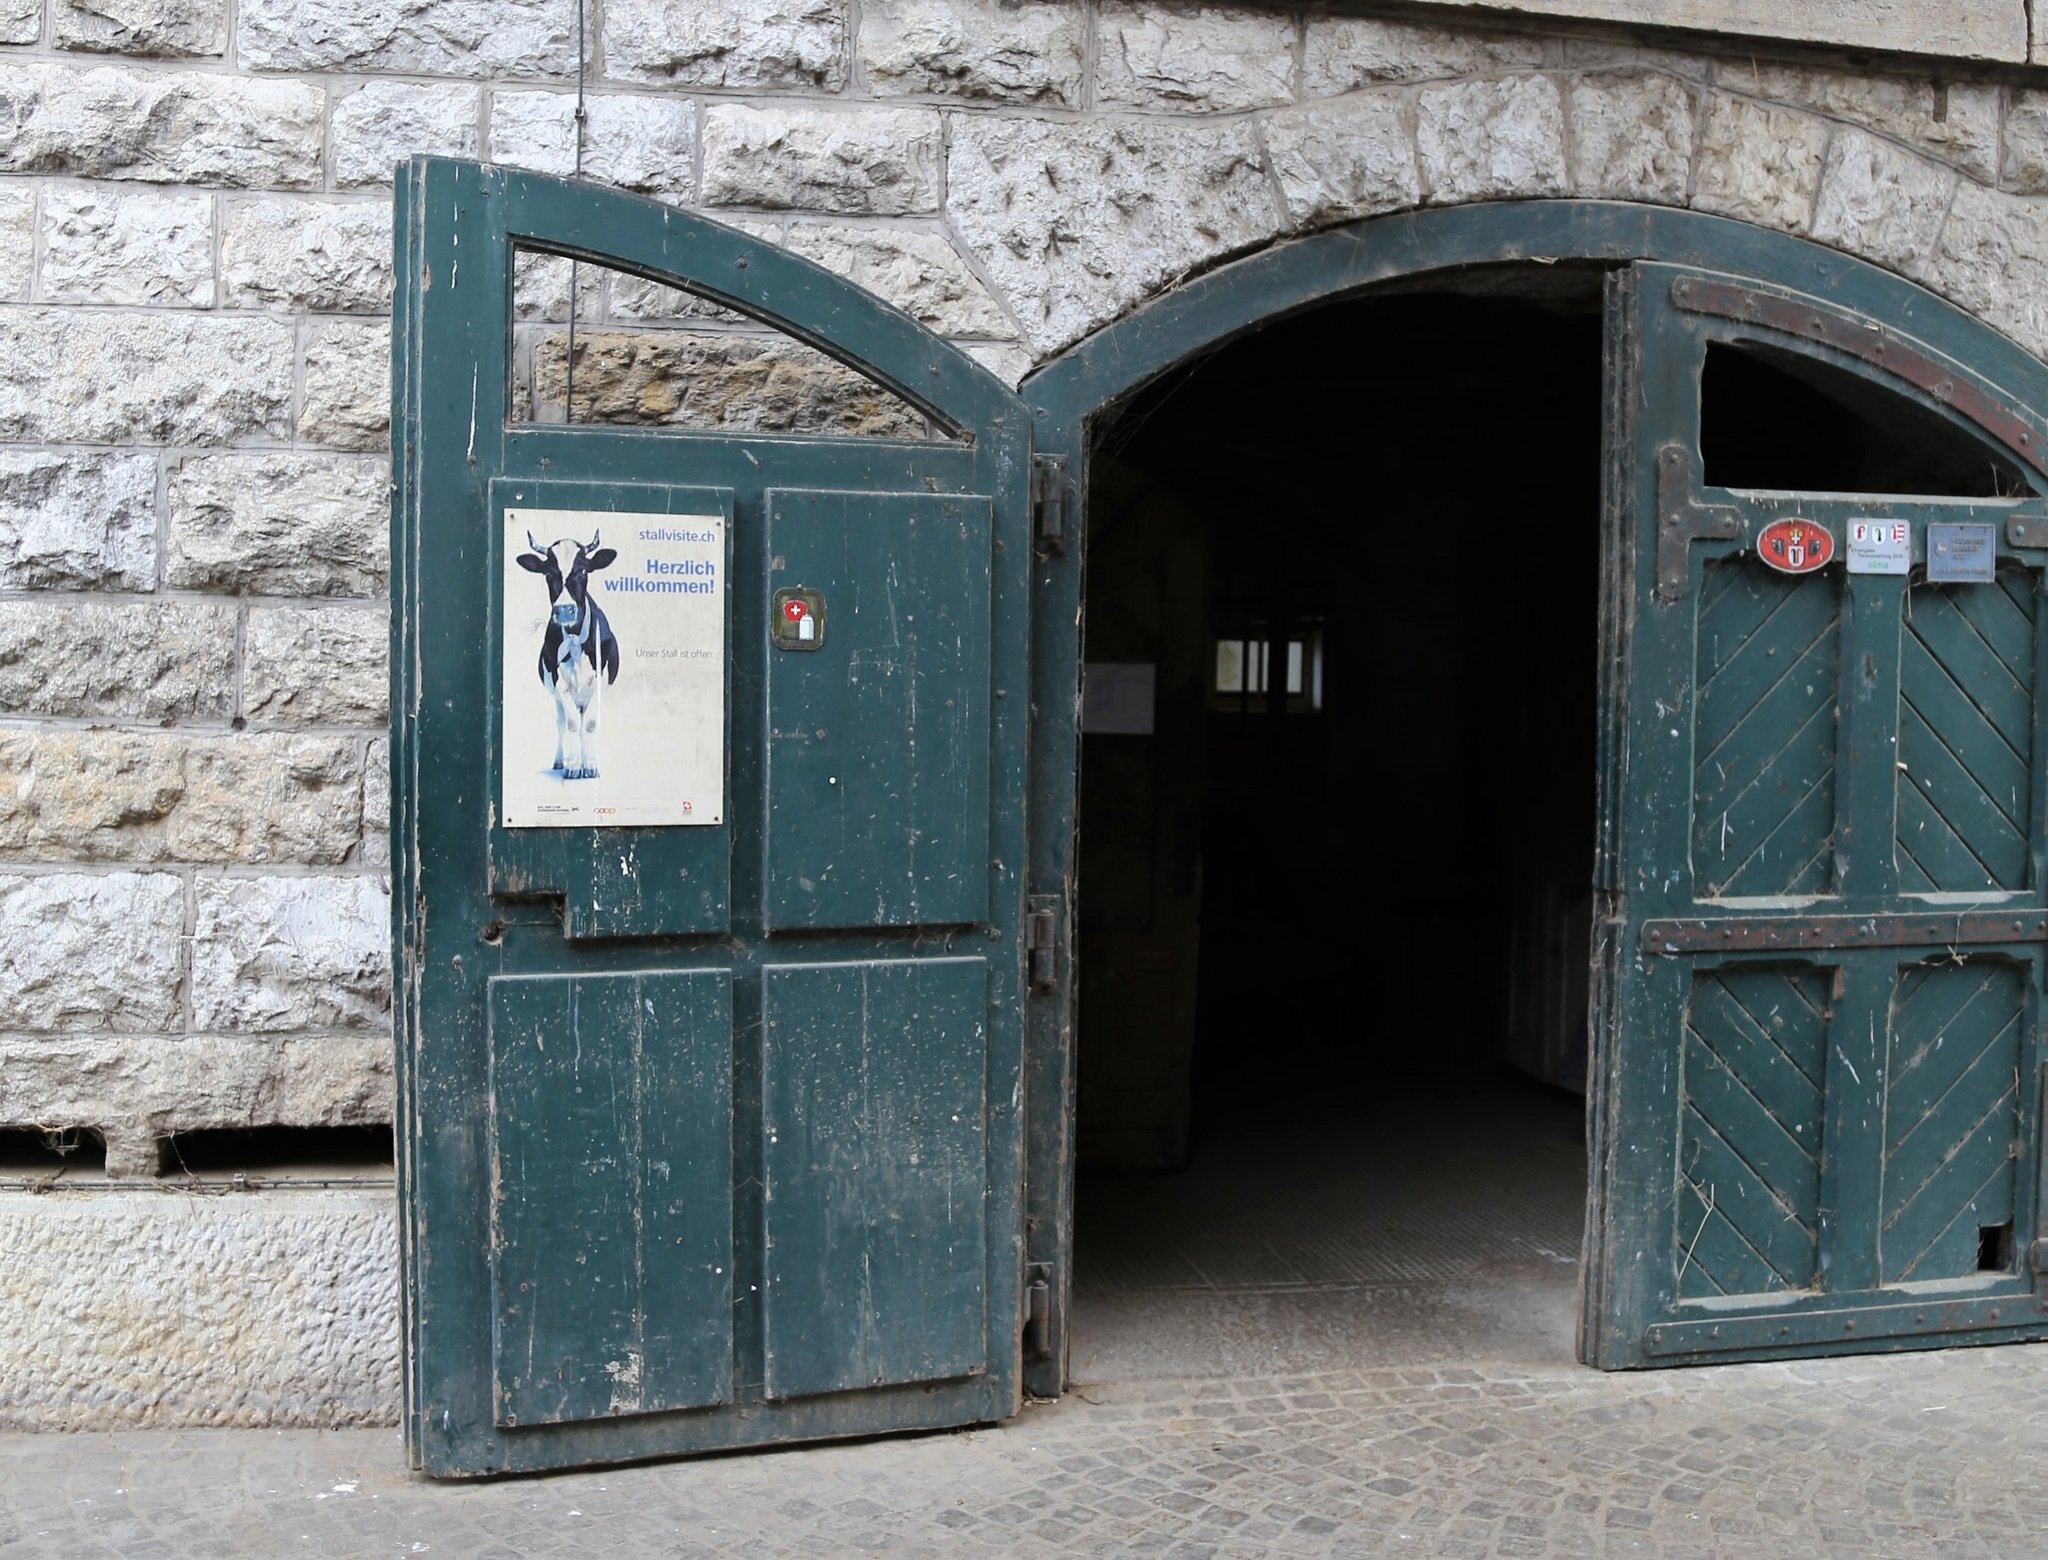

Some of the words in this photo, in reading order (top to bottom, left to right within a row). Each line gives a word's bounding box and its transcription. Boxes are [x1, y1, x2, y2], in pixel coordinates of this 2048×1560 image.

[639, 529, 715, 542] stallvisite.ch
[646, 559, 715, 575] Herzlich
[1867, 560, 1889, 569] olma
[604, 577, 715, 594] willkommen!
[635, 649, 659, 658] Unser
[661, 649, 678, 658] Stall
[680, 650, 689, 658] ist
[593, 807, 616, 816] coop
